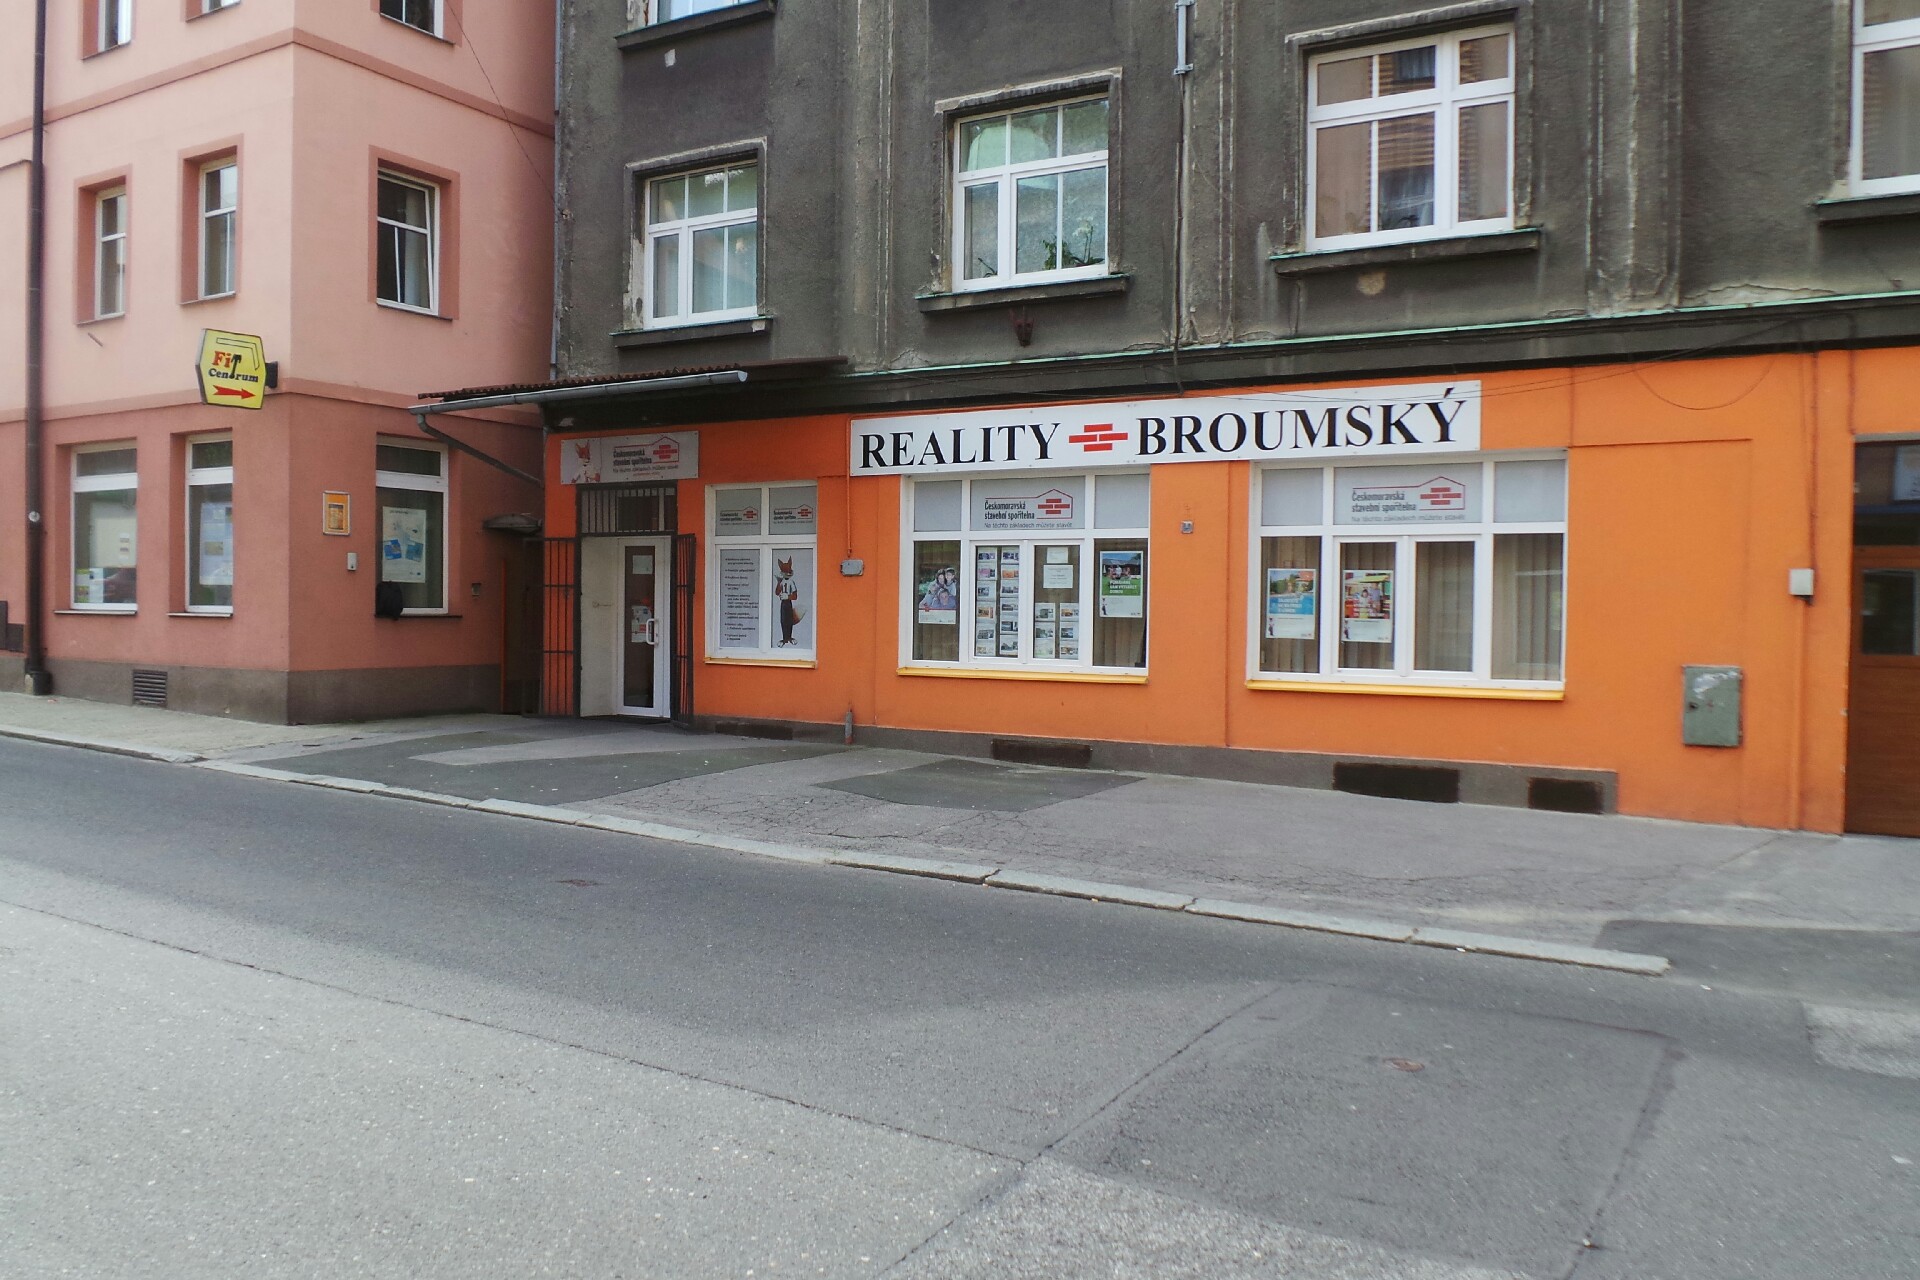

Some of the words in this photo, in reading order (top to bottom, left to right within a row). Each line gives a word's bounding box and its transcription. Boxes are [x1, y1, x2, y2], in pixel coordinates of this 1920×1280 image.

[859, 422, 1061, 468] REALITY
[1136, 387, 1467, 456] BROUMSKÝ
[984, 500, 1026, 510] Českomoravská
[984, 511, 1007, 520] stavební
[1007, 510, 1035, 521] spořitelna
